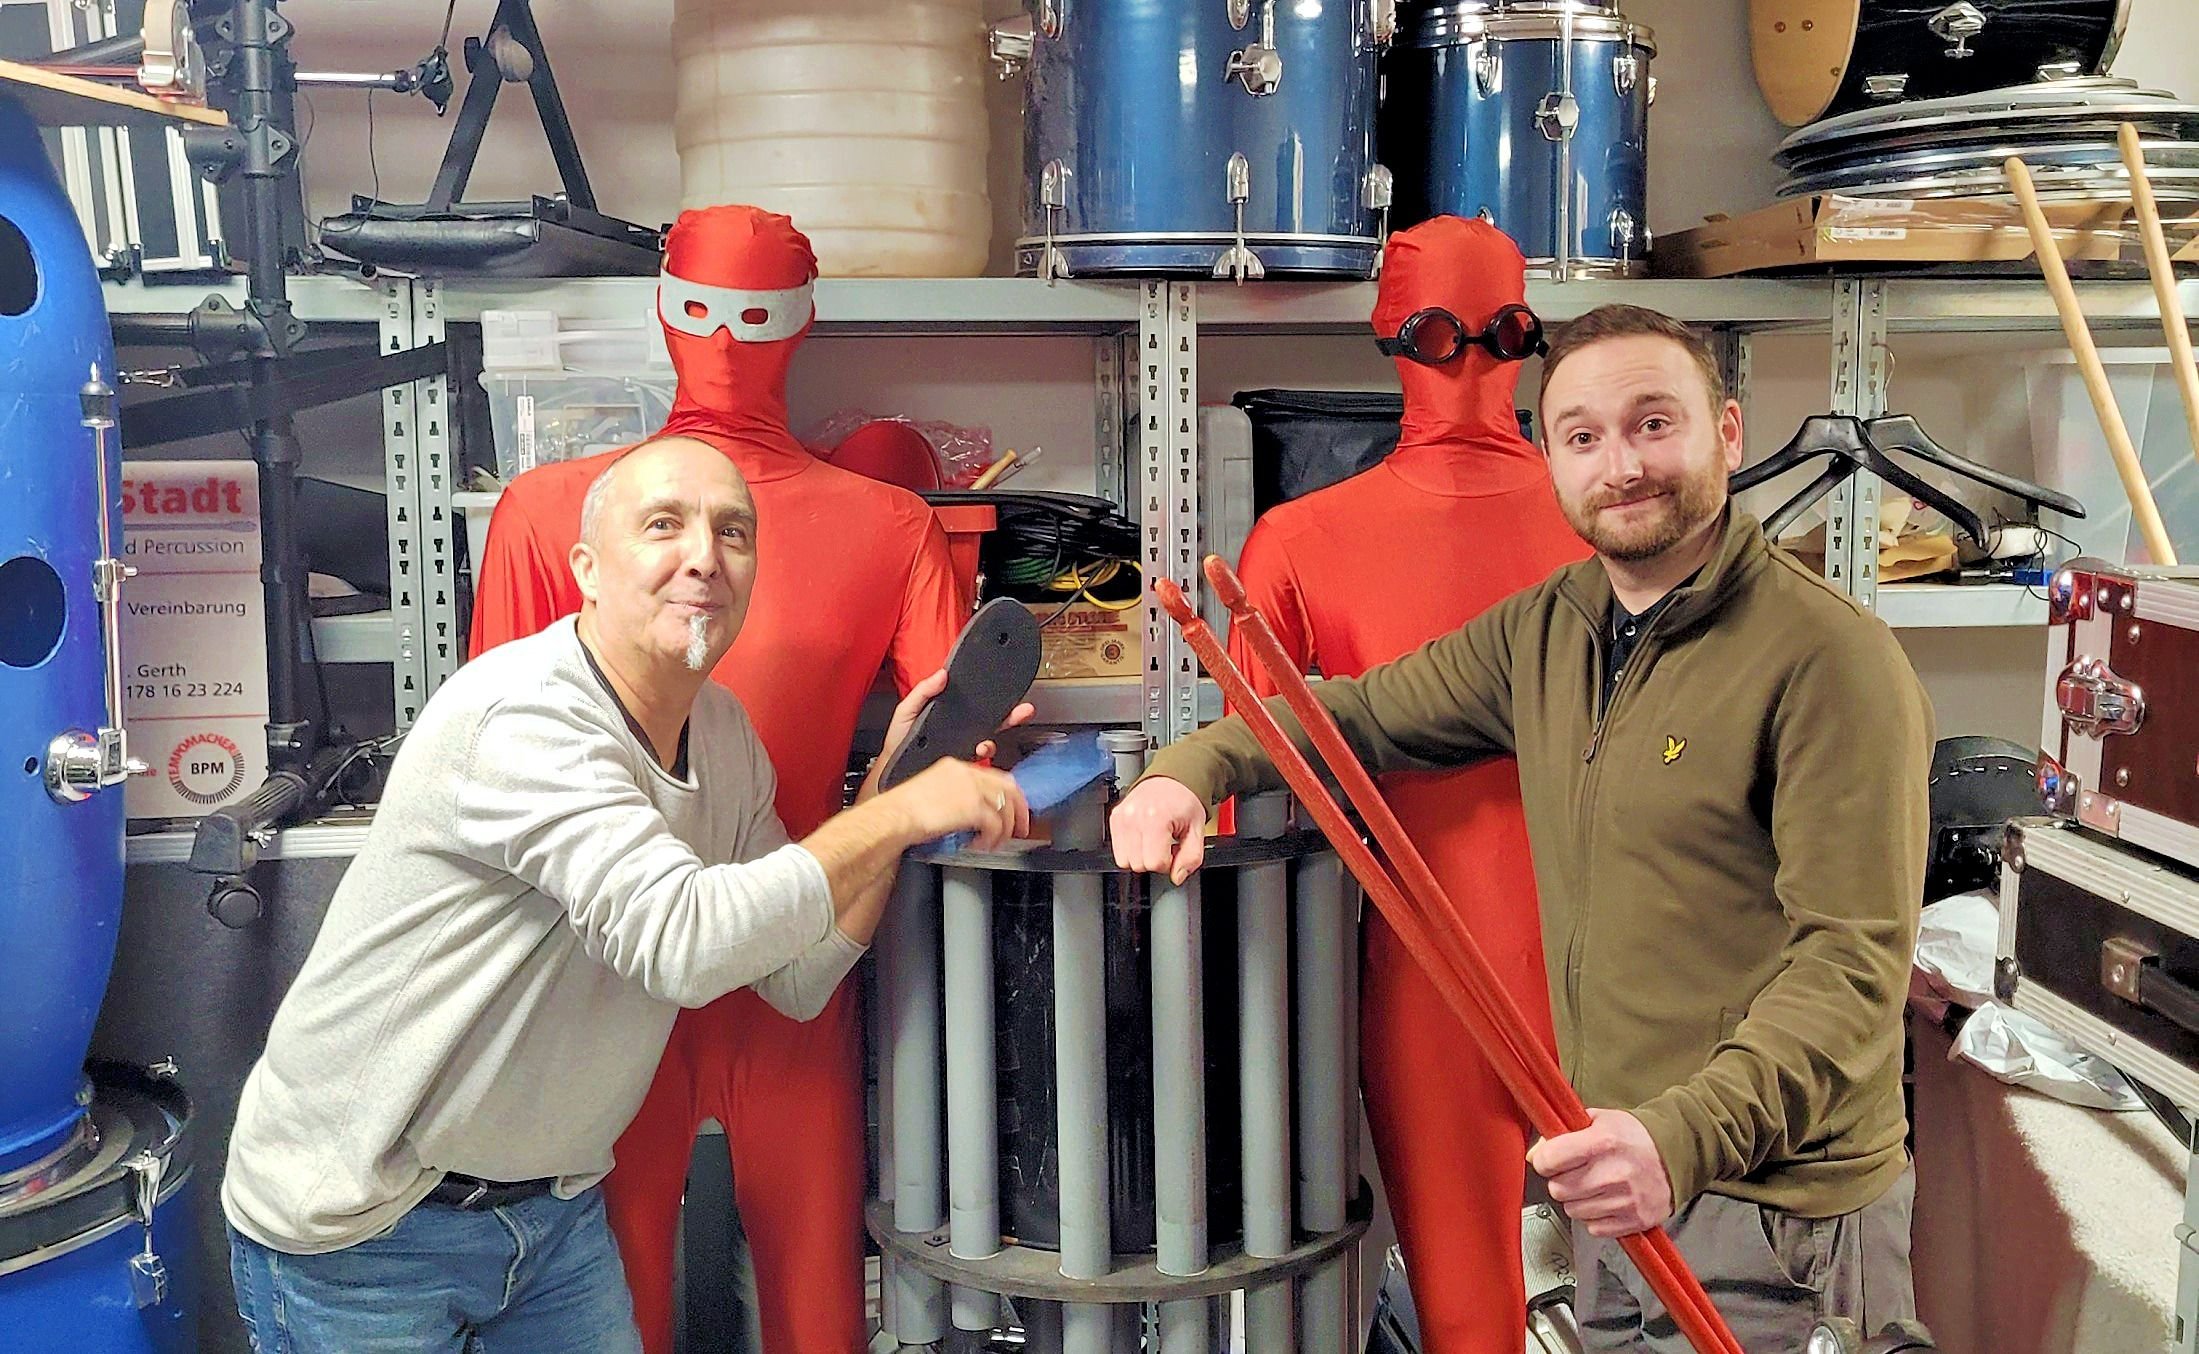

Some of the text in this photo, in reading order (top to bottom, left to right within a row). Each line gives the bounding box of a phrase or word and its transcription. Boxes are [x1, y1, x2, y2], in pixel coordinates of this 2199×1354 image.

[144, 540, 244, 554] Percussion
[127, 601, 246, 617] Vereinbarung
[137, 663, 186, 678] Gerth
[127, 682, 242, 699] 178 16 23 224
[168, 733, 238, 784] TEMPOMACHER
[191, 762, 224, 775] BPM
